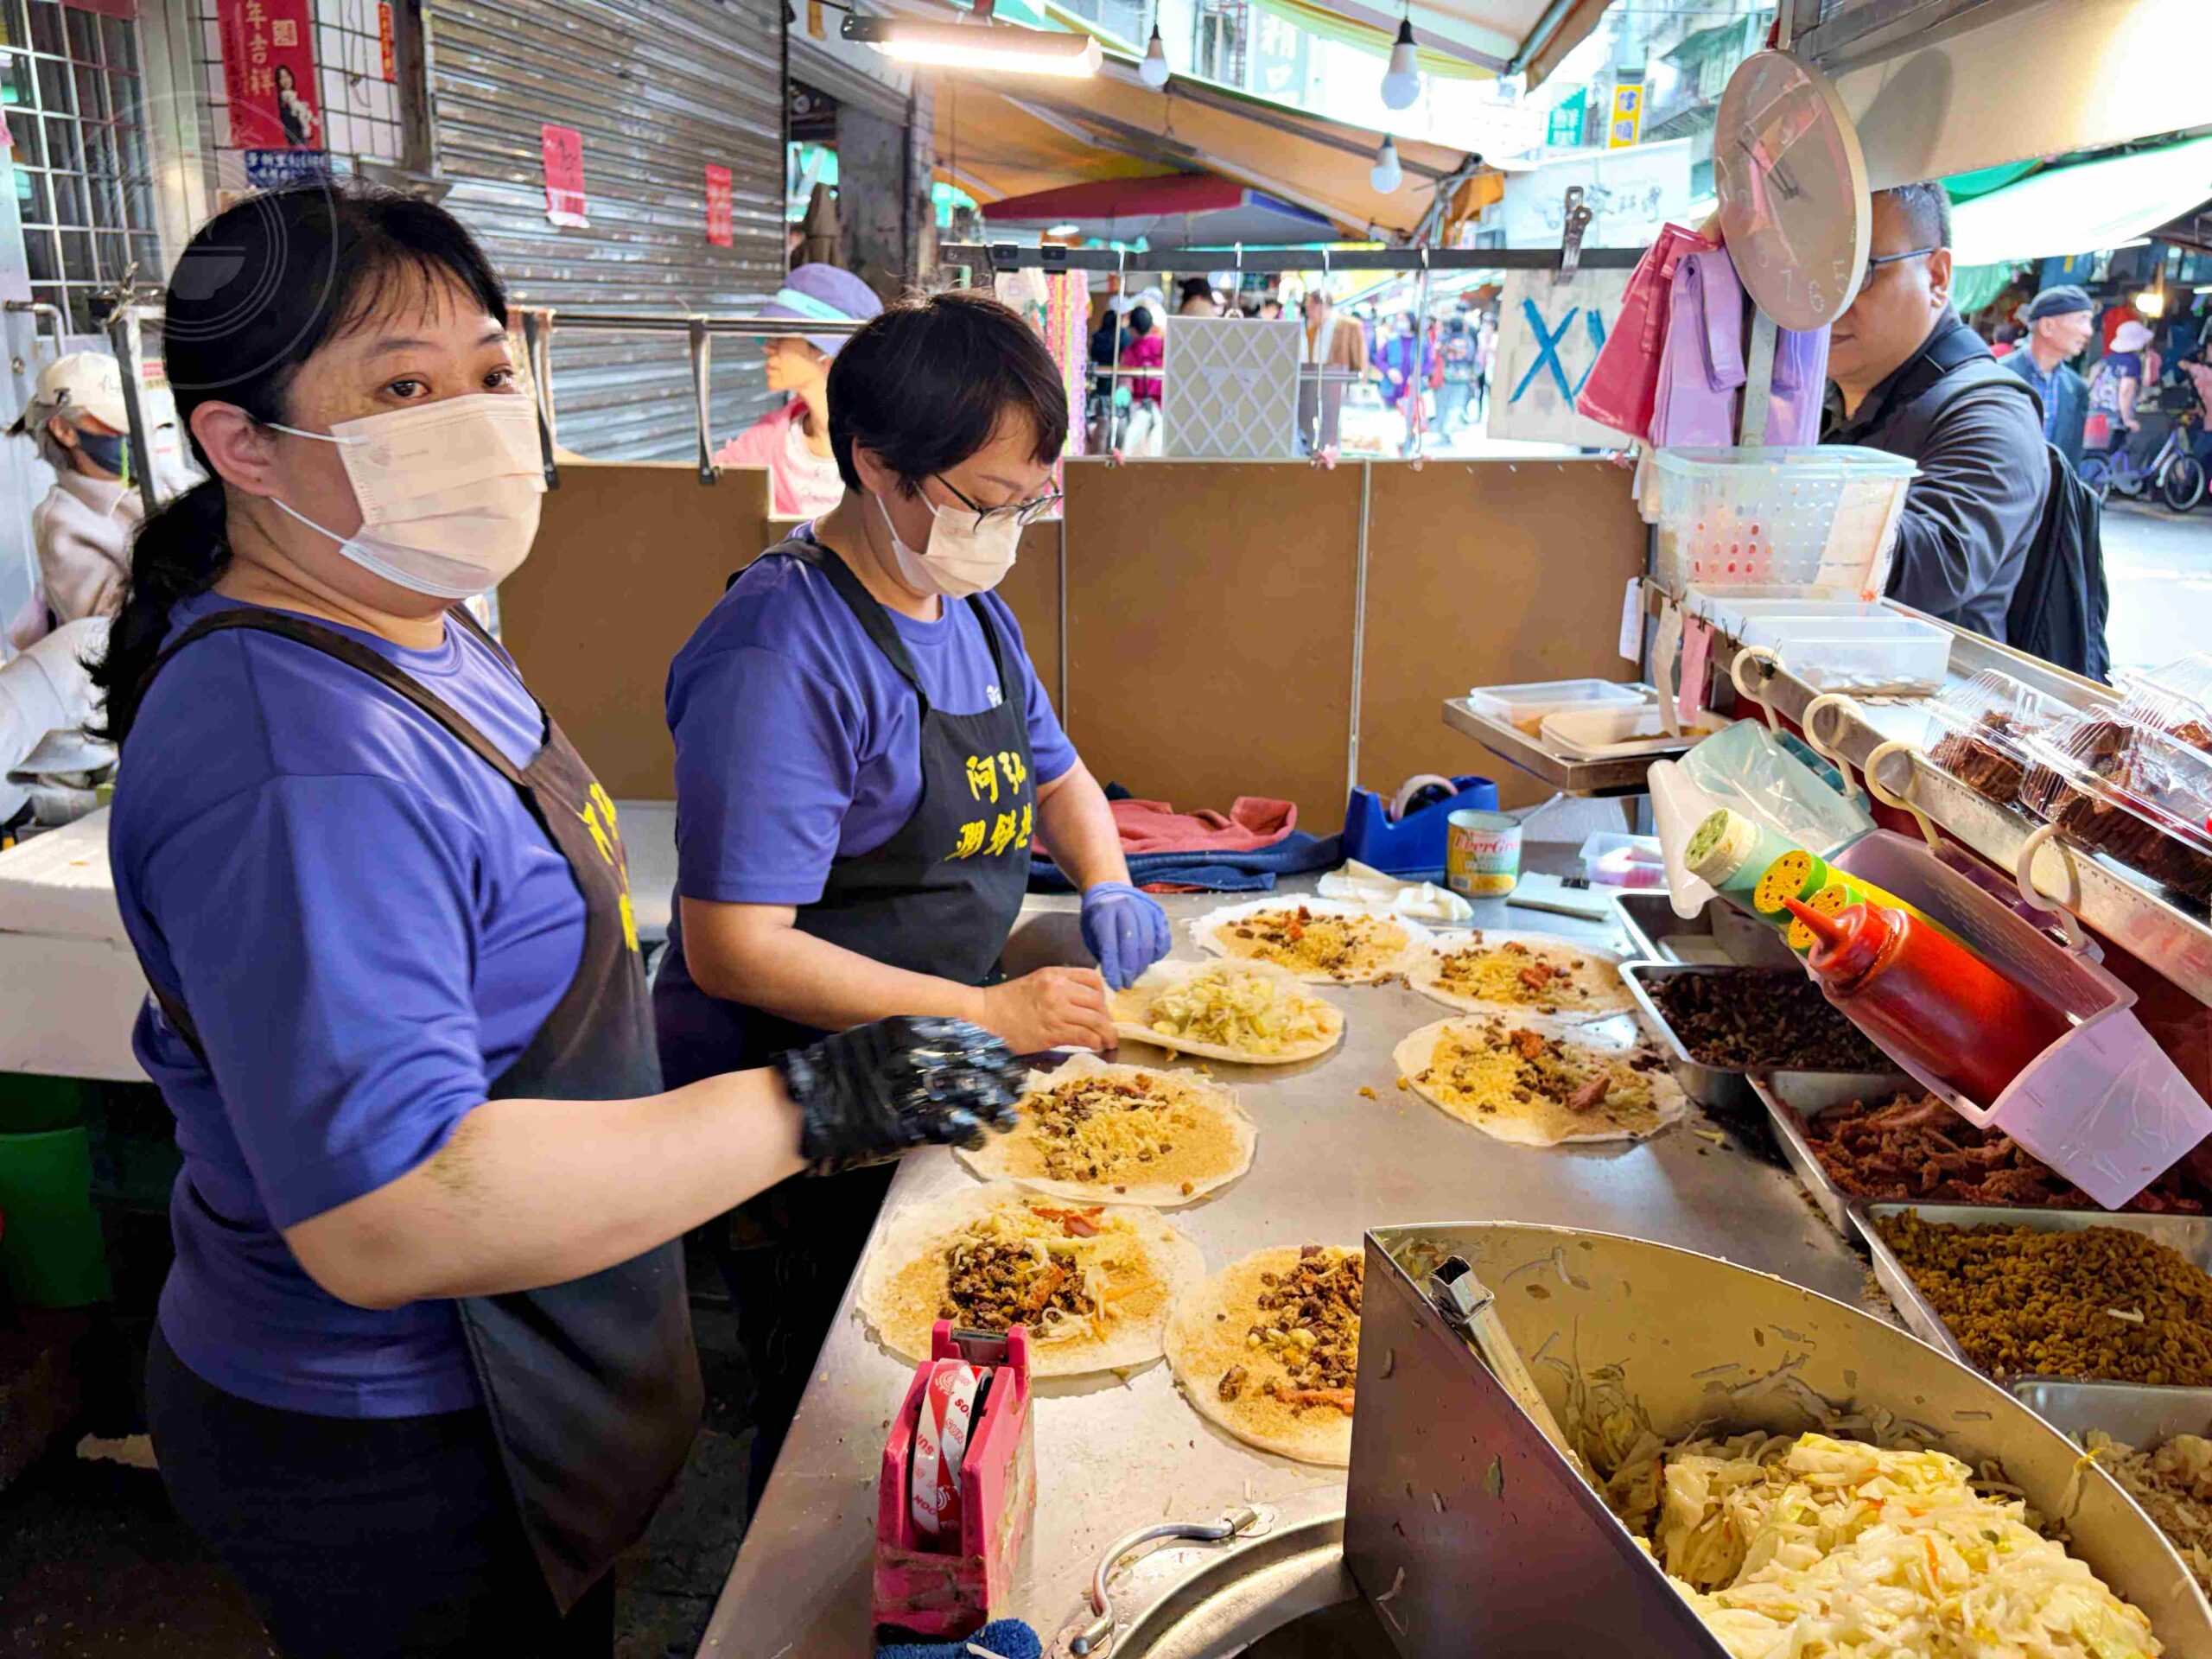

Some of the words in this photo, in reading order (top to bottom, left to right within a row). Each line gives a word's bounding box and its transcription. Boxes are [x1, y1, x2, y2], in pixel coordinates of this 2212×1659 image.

[1780, 268, 1792, 302] 7
[1808, 280, 1825, 313] 6
[944, 1418, 965, 1445] SUN
